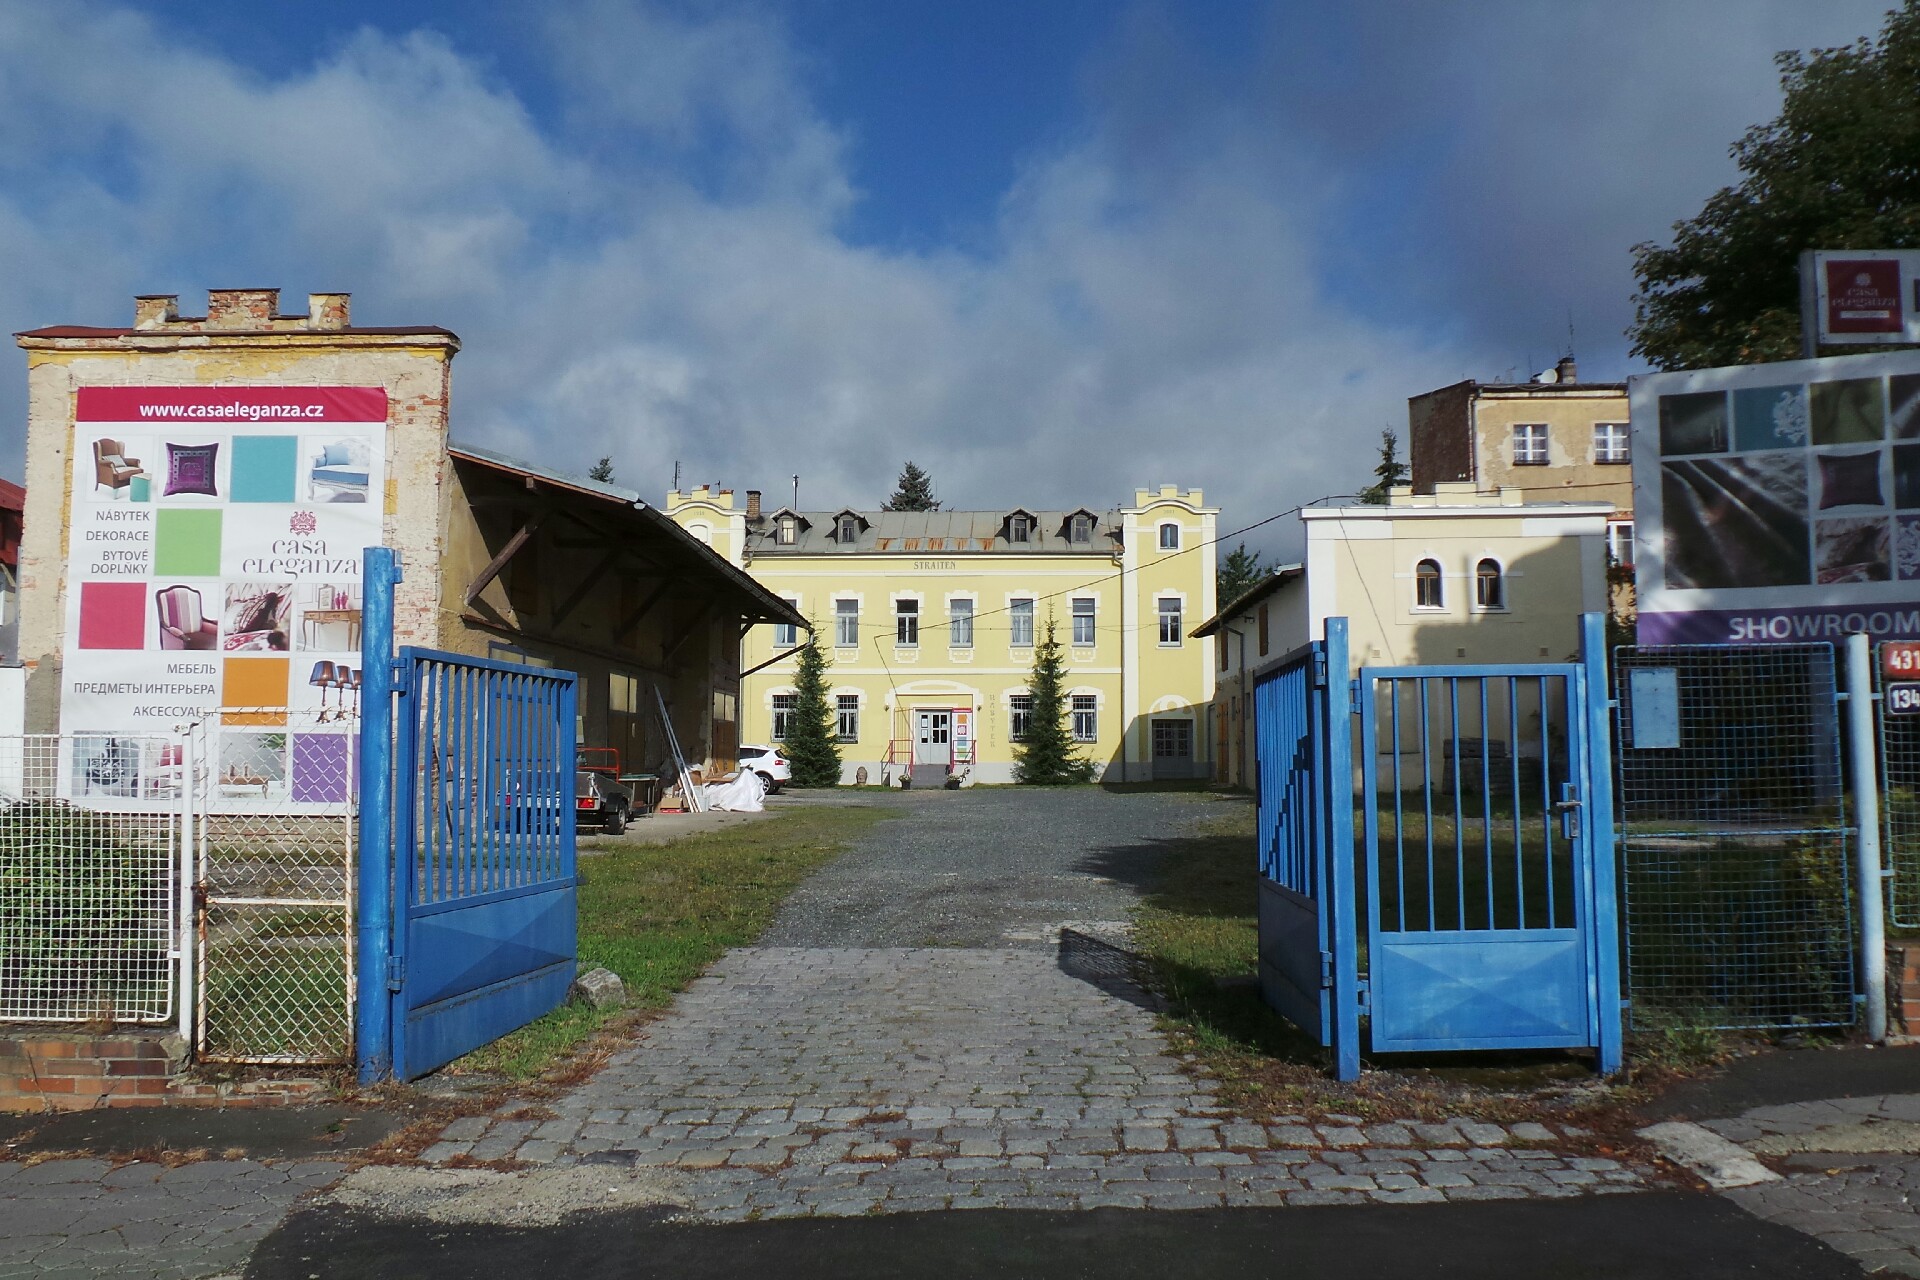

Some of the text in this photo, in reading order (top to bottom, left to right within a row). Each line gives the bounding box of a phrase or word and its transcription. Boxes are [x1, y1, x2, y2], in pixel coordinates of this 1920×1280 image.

[139, 401, 324, 421] www.casaeleganza.cz
[95, 508, 150, 521] NÁBYTEK
[85, 530, 149, 542] DEKORACE
[102, 548, 149, 562] BYTOVÉ
[90, 561, 148, 575] DOPLŇKY
[1728, 610, 1920, 640] SHOWROOM
[166, 663, 217, 675] МЕБЕЛЬ
[73, 683, 216, 696] ПРЕДМЕТЫ ИНТЕРЬЕРА
